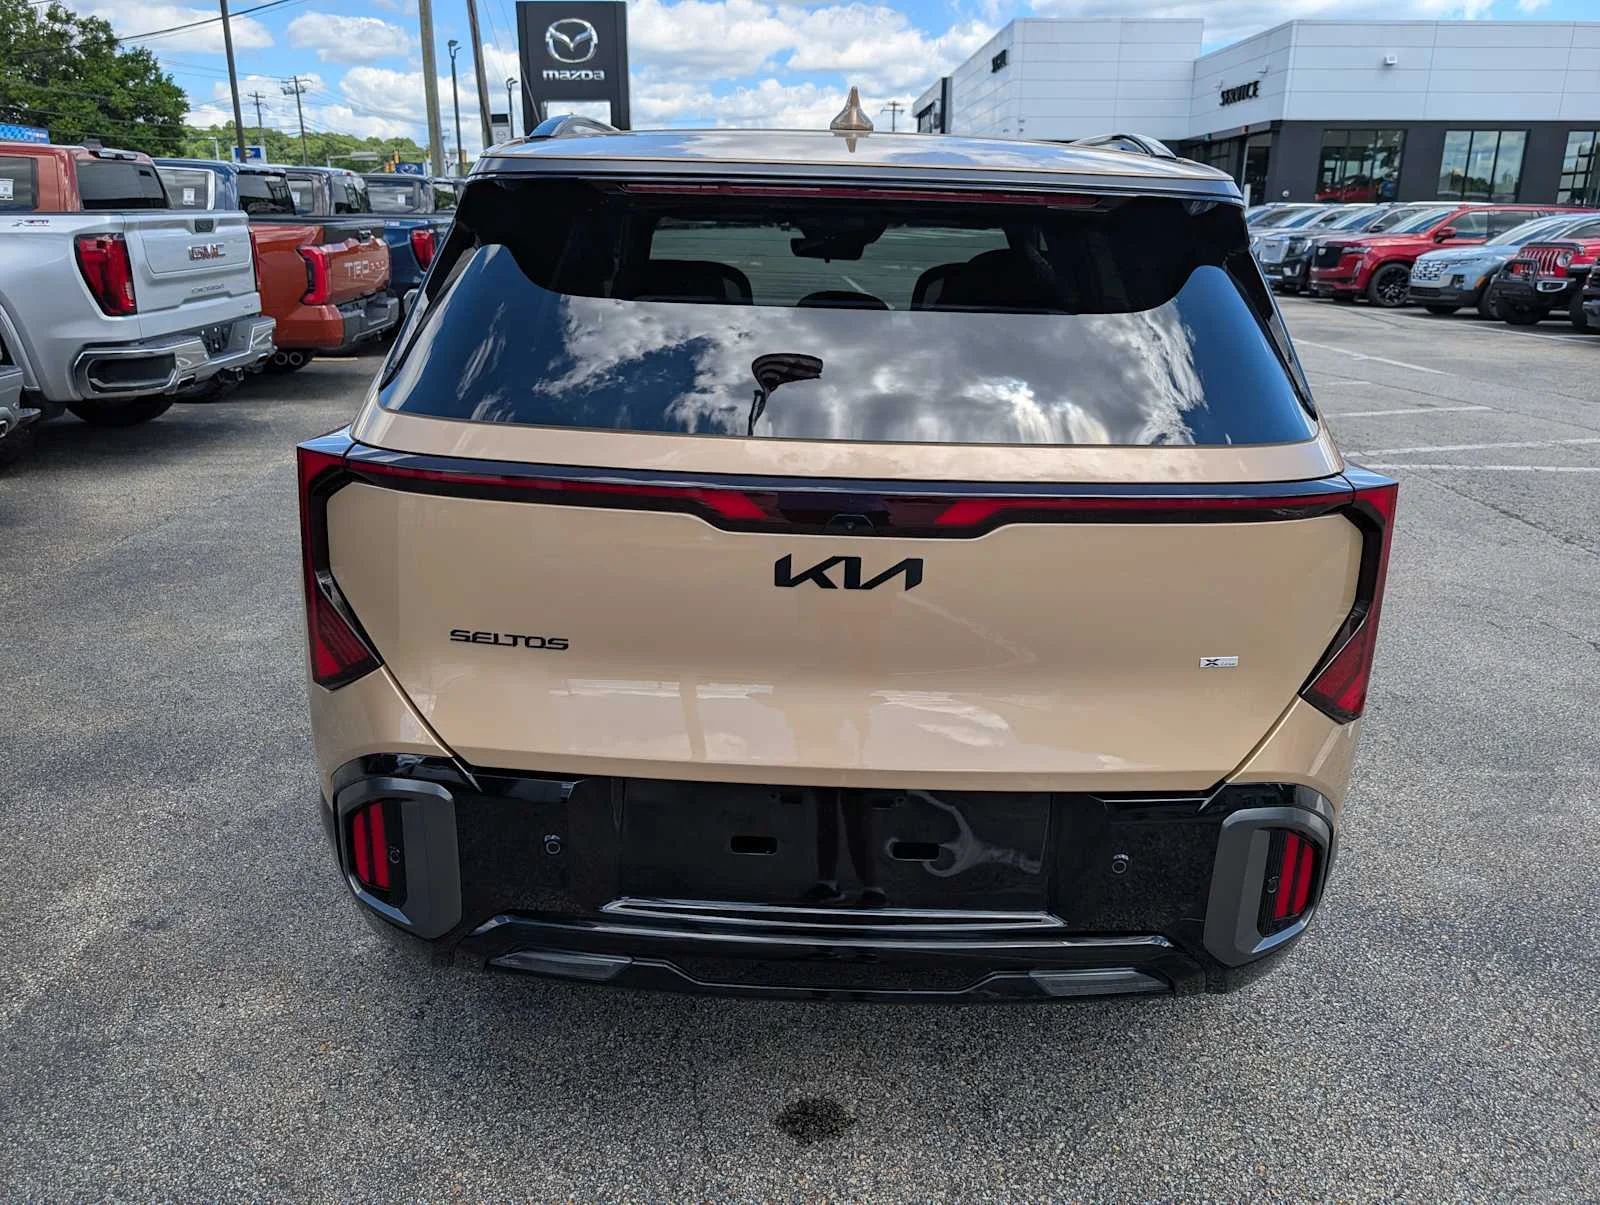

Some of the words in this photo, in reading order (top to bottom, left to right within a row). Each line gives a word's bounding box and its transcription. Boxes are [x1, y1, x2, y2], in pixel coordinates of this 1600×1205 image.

[1219, 80, 1260, 106] SERVICE
[188, 242, 226, 260] GMC
[774, 553, 924, 591] KIA
[450, 629, 569, 650] SELTOS
